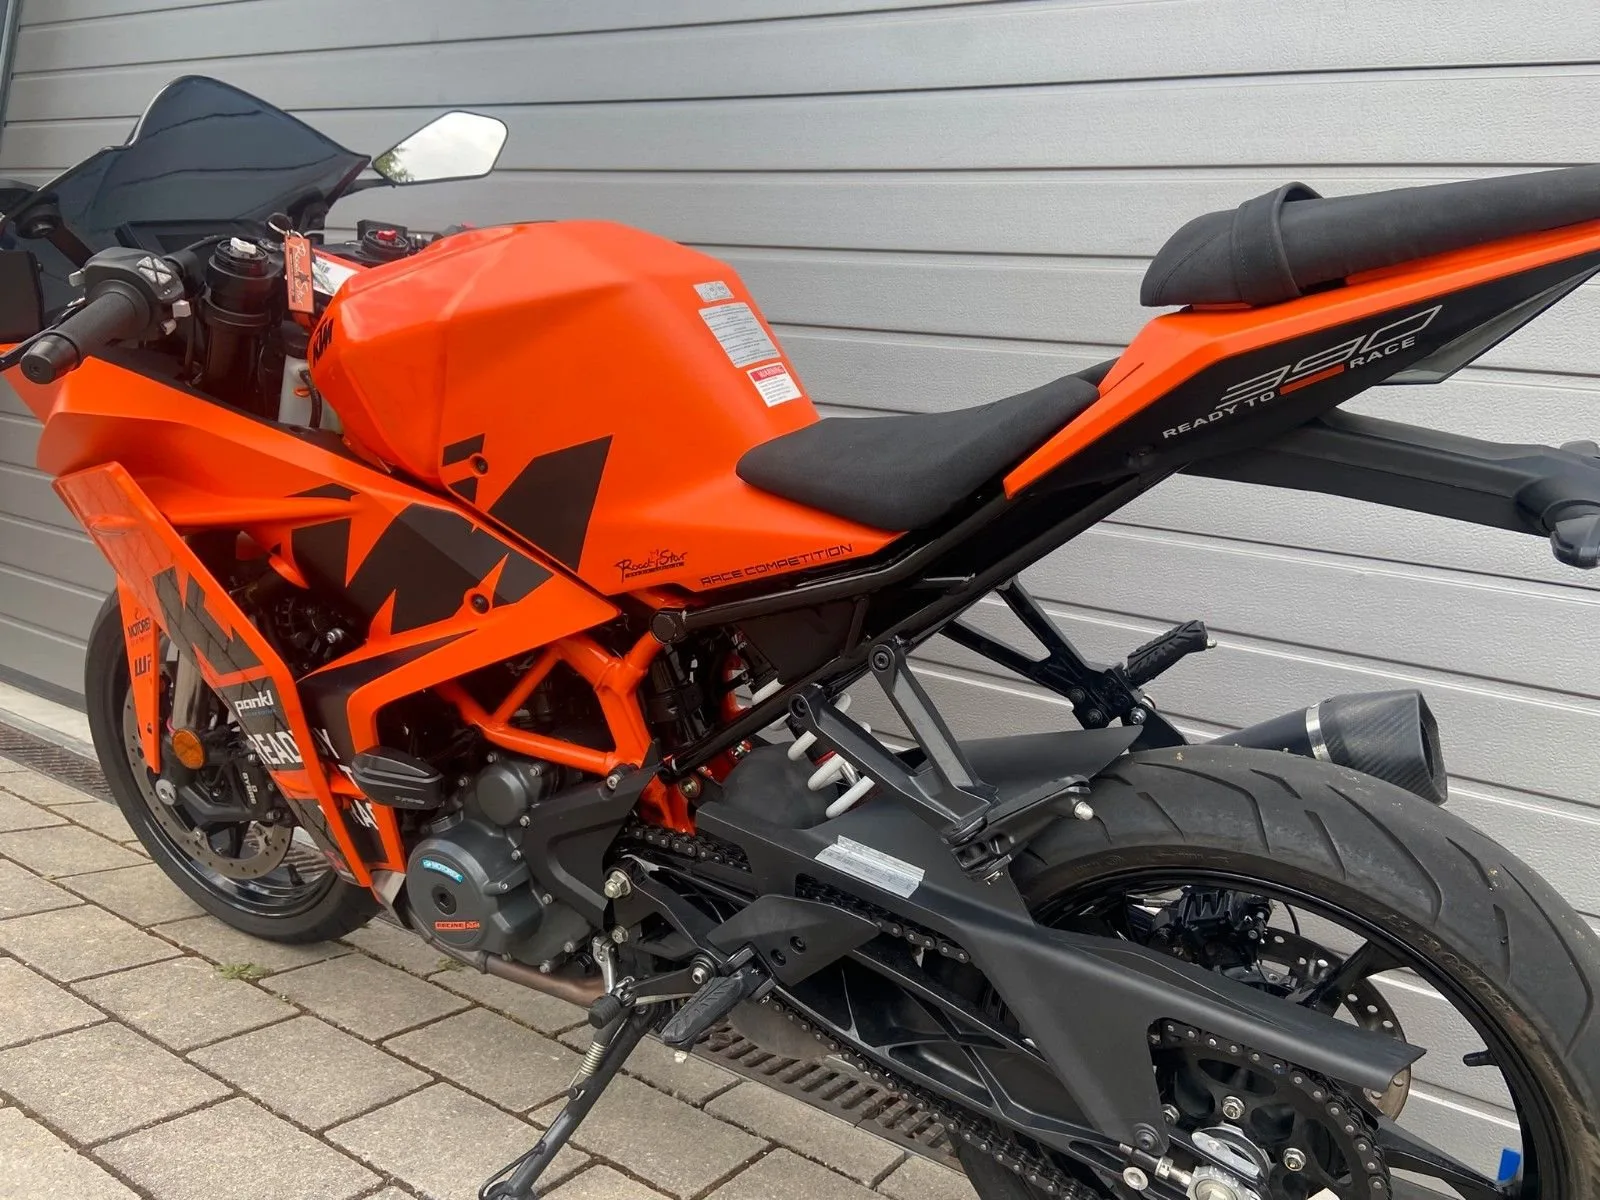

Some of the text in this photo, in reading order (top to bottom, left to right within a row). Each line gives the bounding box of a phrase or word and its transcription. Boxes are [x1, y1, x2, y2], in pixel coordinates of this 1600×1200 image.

[1162, 335, 1416, 439] READY TO RACE
[701, 544, 853, 587] RACE COMPETITION
[234, 689, 274, 717] pankl
